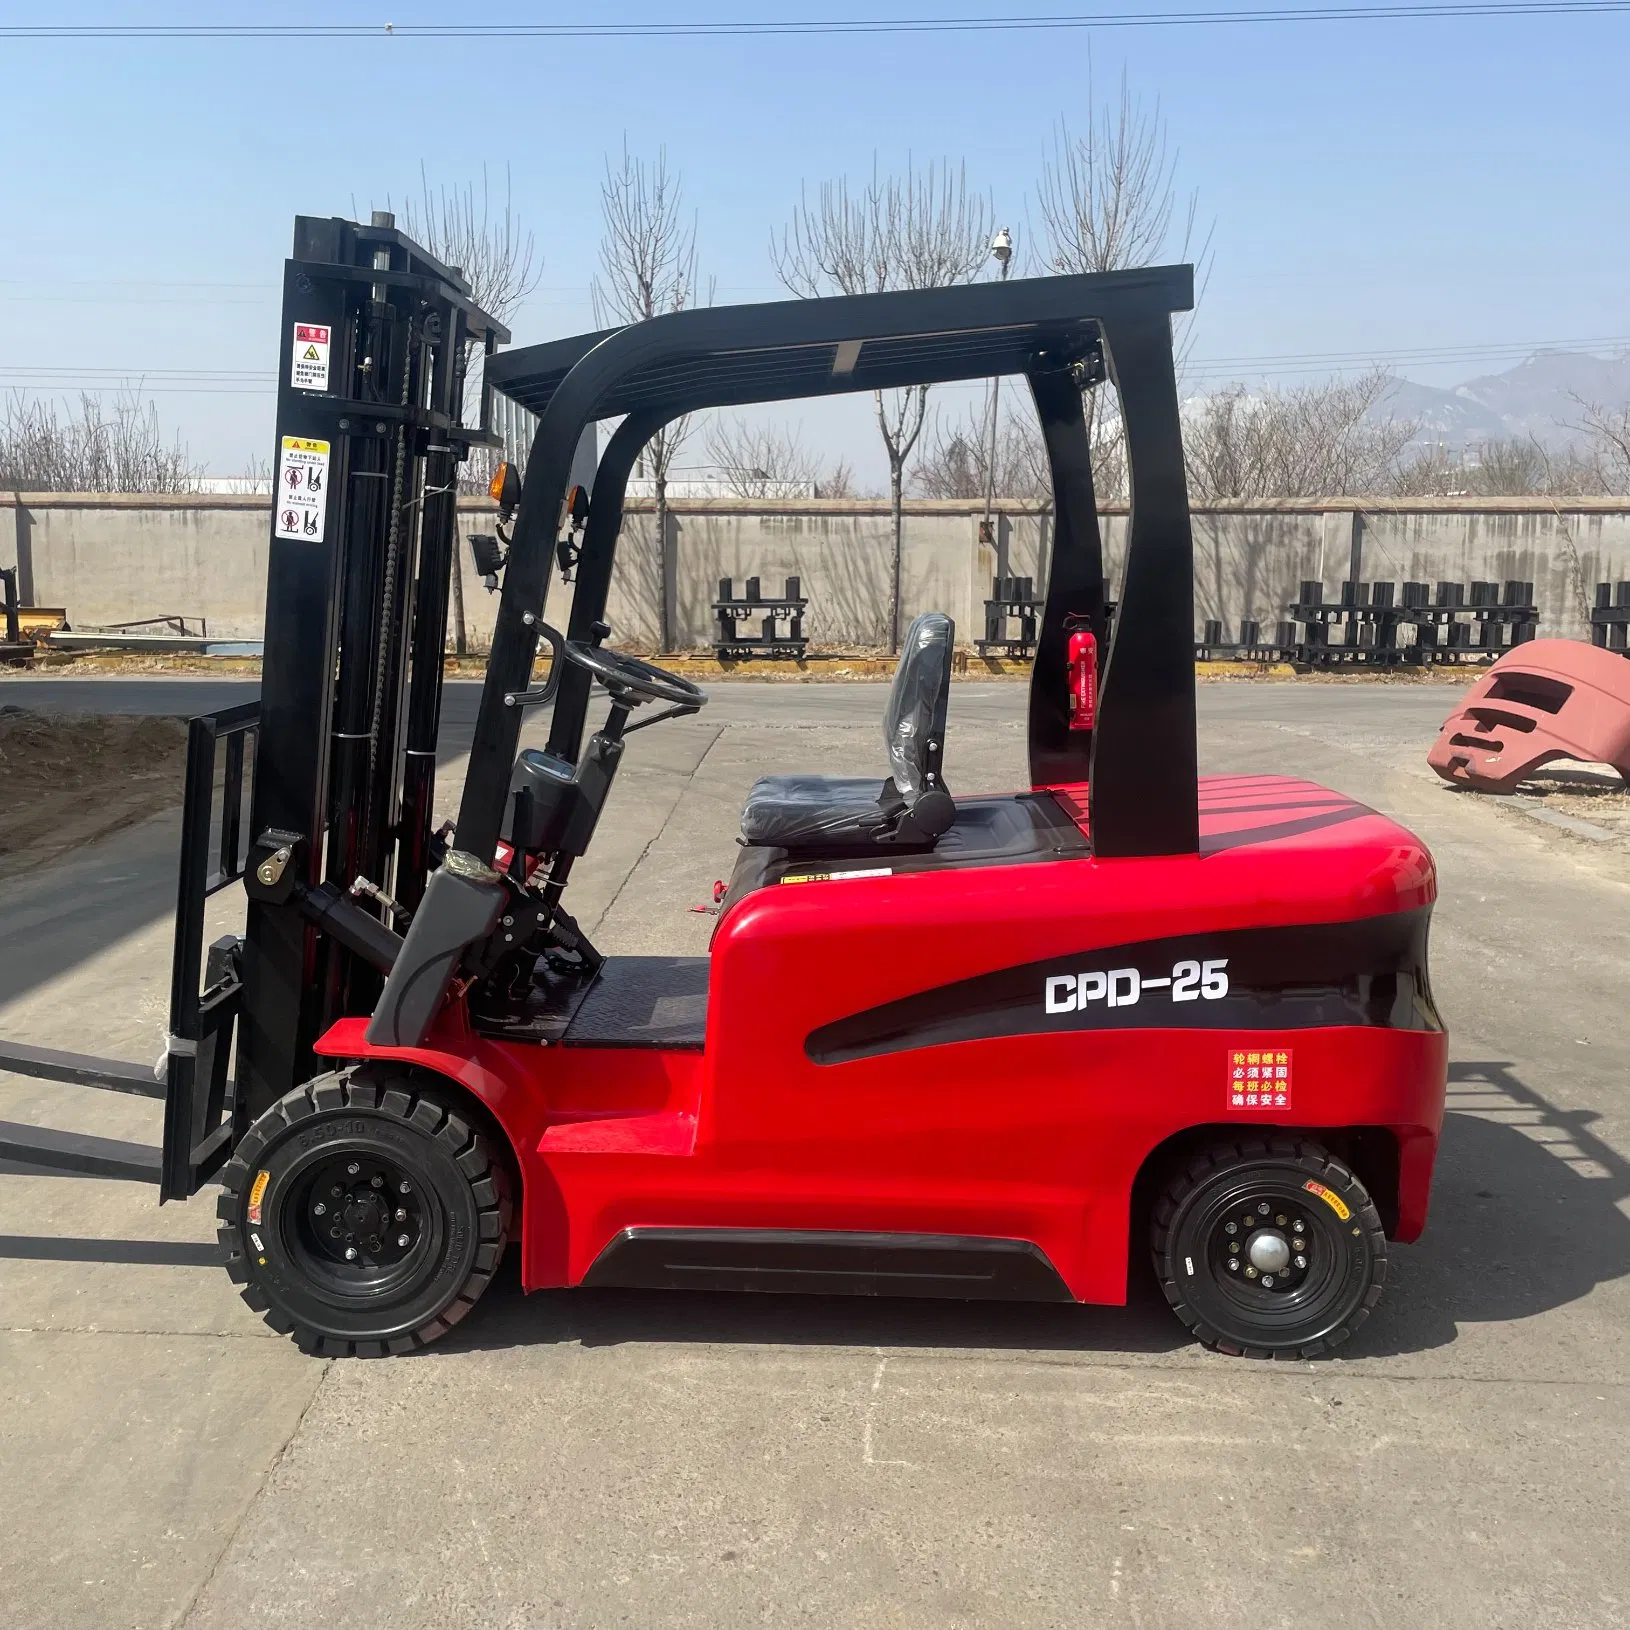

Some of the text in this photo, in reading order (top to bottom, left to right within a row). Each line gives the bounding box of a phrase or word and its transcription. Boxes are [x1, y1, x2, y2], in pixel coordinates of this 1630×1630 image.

[1045, 958, 1229, 1014] CPD-25
[1232, 1067, 1288, 1079] 必须紧固
[1232, 1080, 1288, 1092] 每班必检
[1231, 1094, 1287, 1106] 确保安全
